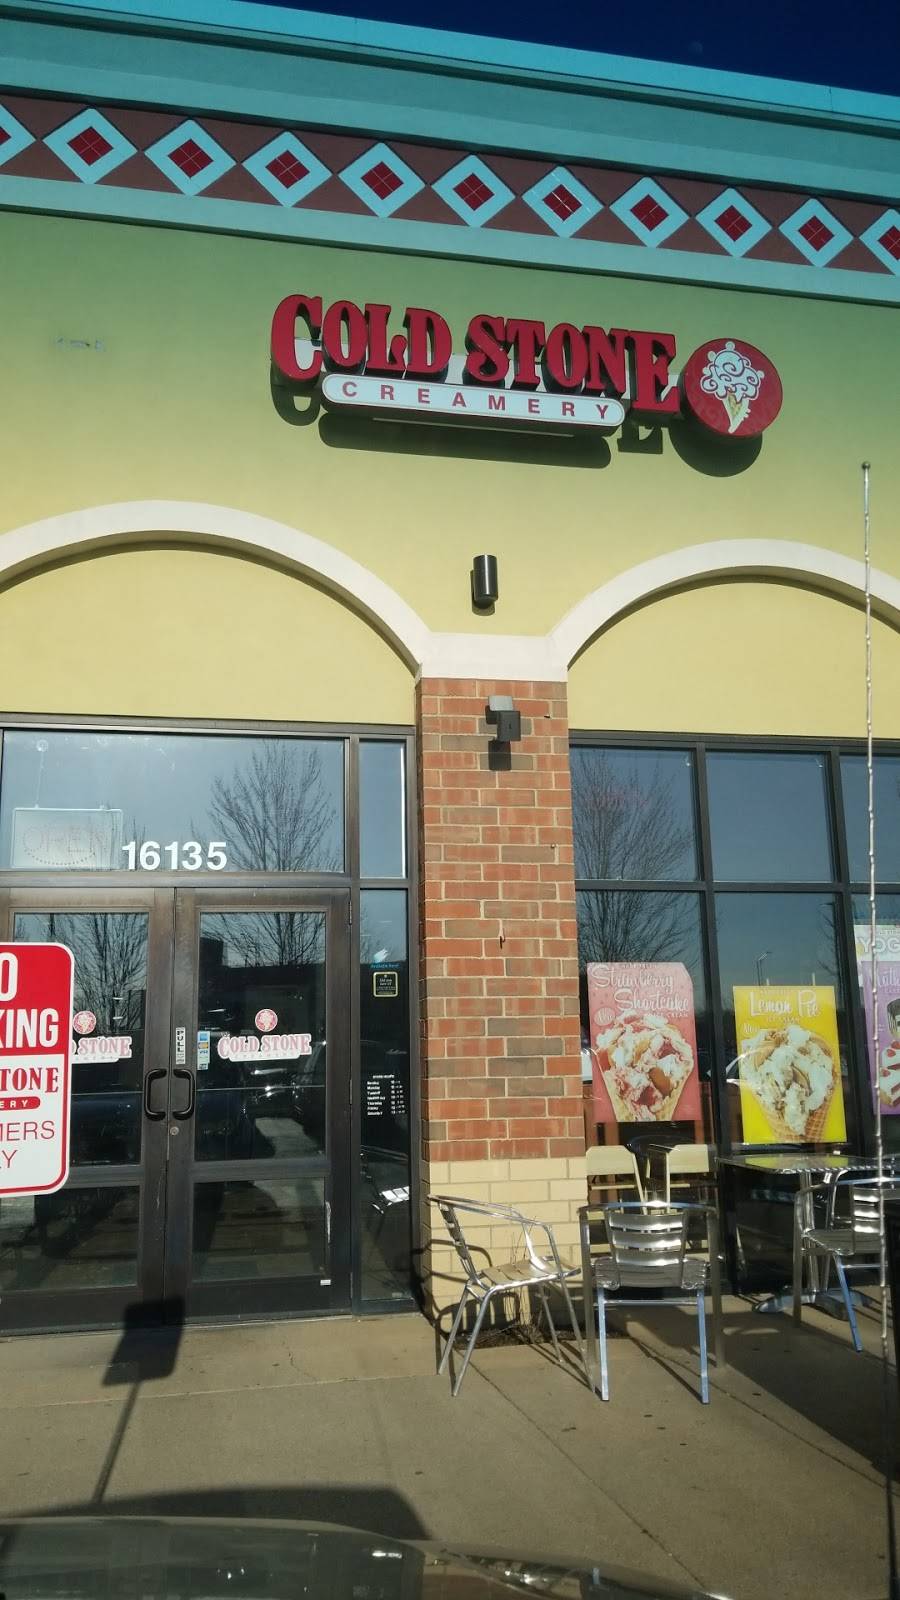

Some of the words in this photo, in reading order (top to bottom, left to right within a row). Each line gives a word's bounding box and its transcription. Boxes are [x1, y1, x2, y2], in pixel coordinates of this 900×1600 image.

[271, 294, 453, 380] COLD
[465, 314, 681, 413] STONE
[342, 381, 609, 420] CREAMERY
[122, 841, 228, 871] 16135
[614, 988, 689, 1012] Shortcake
[79, 1037, 131, 1056] STONE
[218, 1037, 259, 1058] COLD
[261, 1034, 312, 1055] STONE
[0, 1120, 55, 1142] ERS
